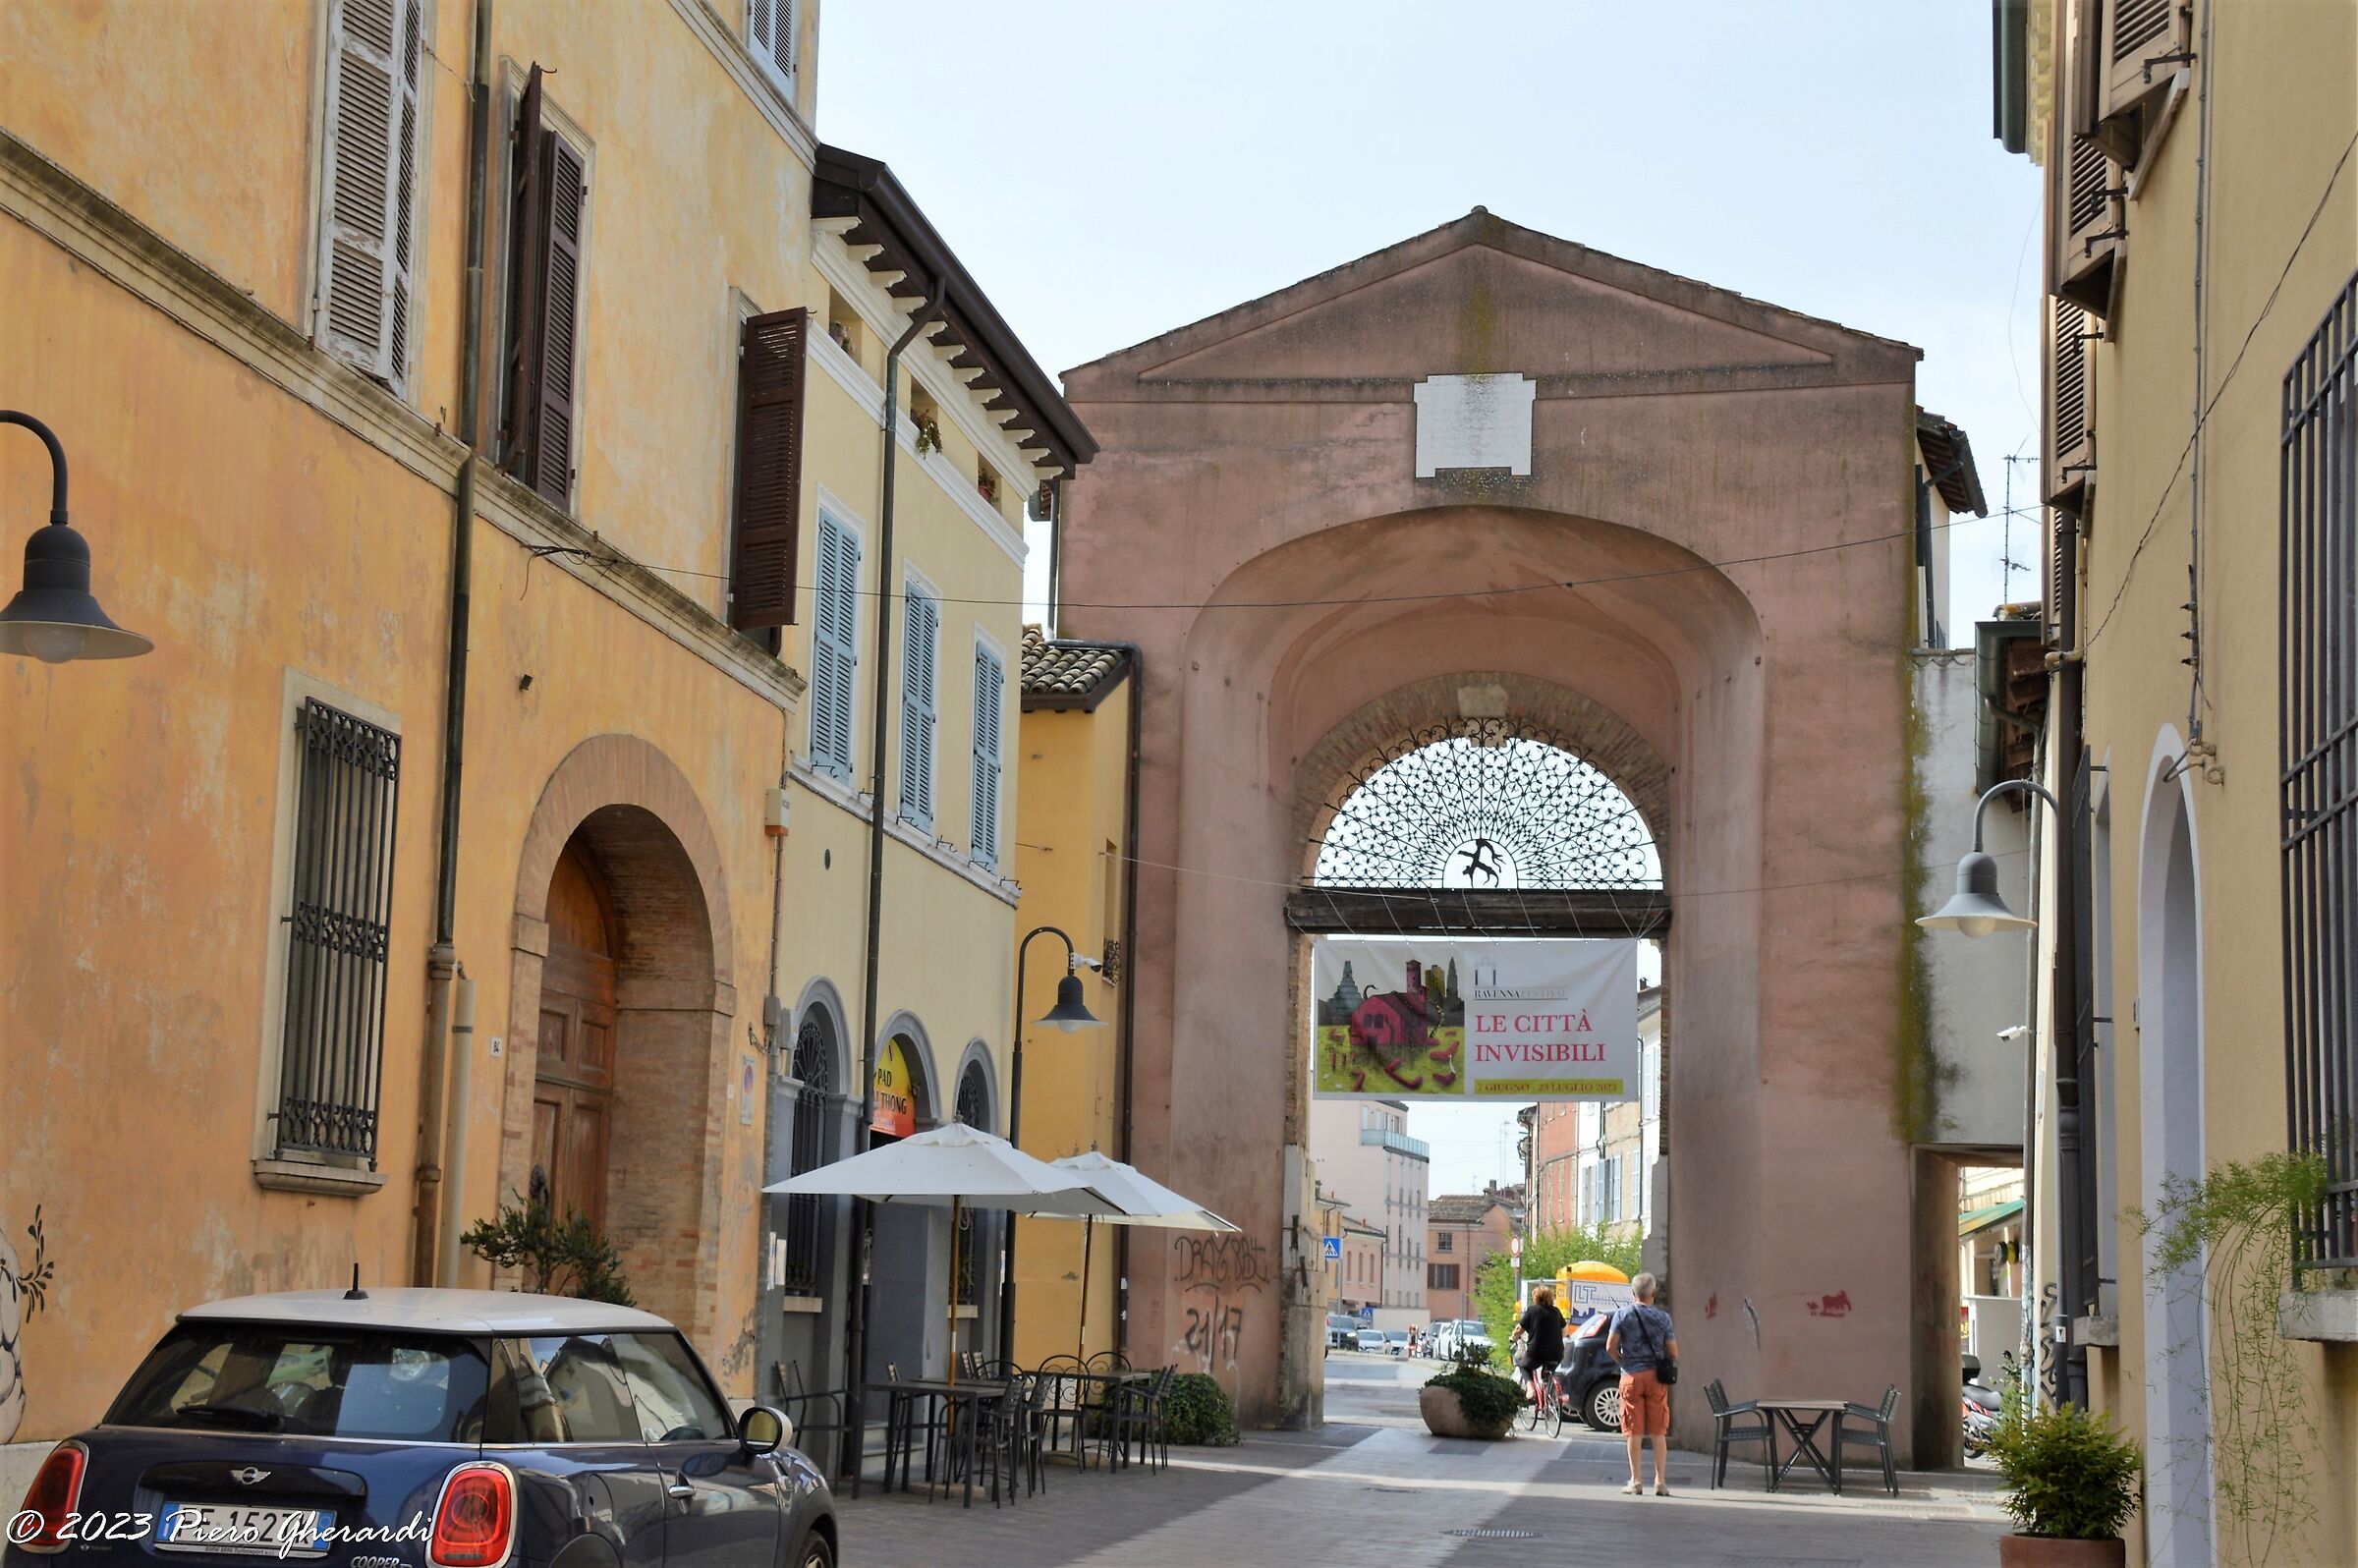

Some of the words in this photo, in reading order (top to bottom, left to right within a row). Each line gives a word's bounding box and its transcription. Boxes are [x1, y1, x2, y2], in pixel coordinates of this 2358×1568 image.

[1475, 1014, 1507, 1033] LE
[1514, 1008, 1593, 1034] CITTÀ
[1475, 1043, 1606, 1062] INVISIBILI
[877, 1068, 892, 1088] PAD
[1485, 1083, 1530, 1092] GIUGNO
[1551, 1083, 1594, 1092] LUGLIO
[880, 1092, 907, 1115] THONG
[351, 1555, 401, 1568] COOPER
